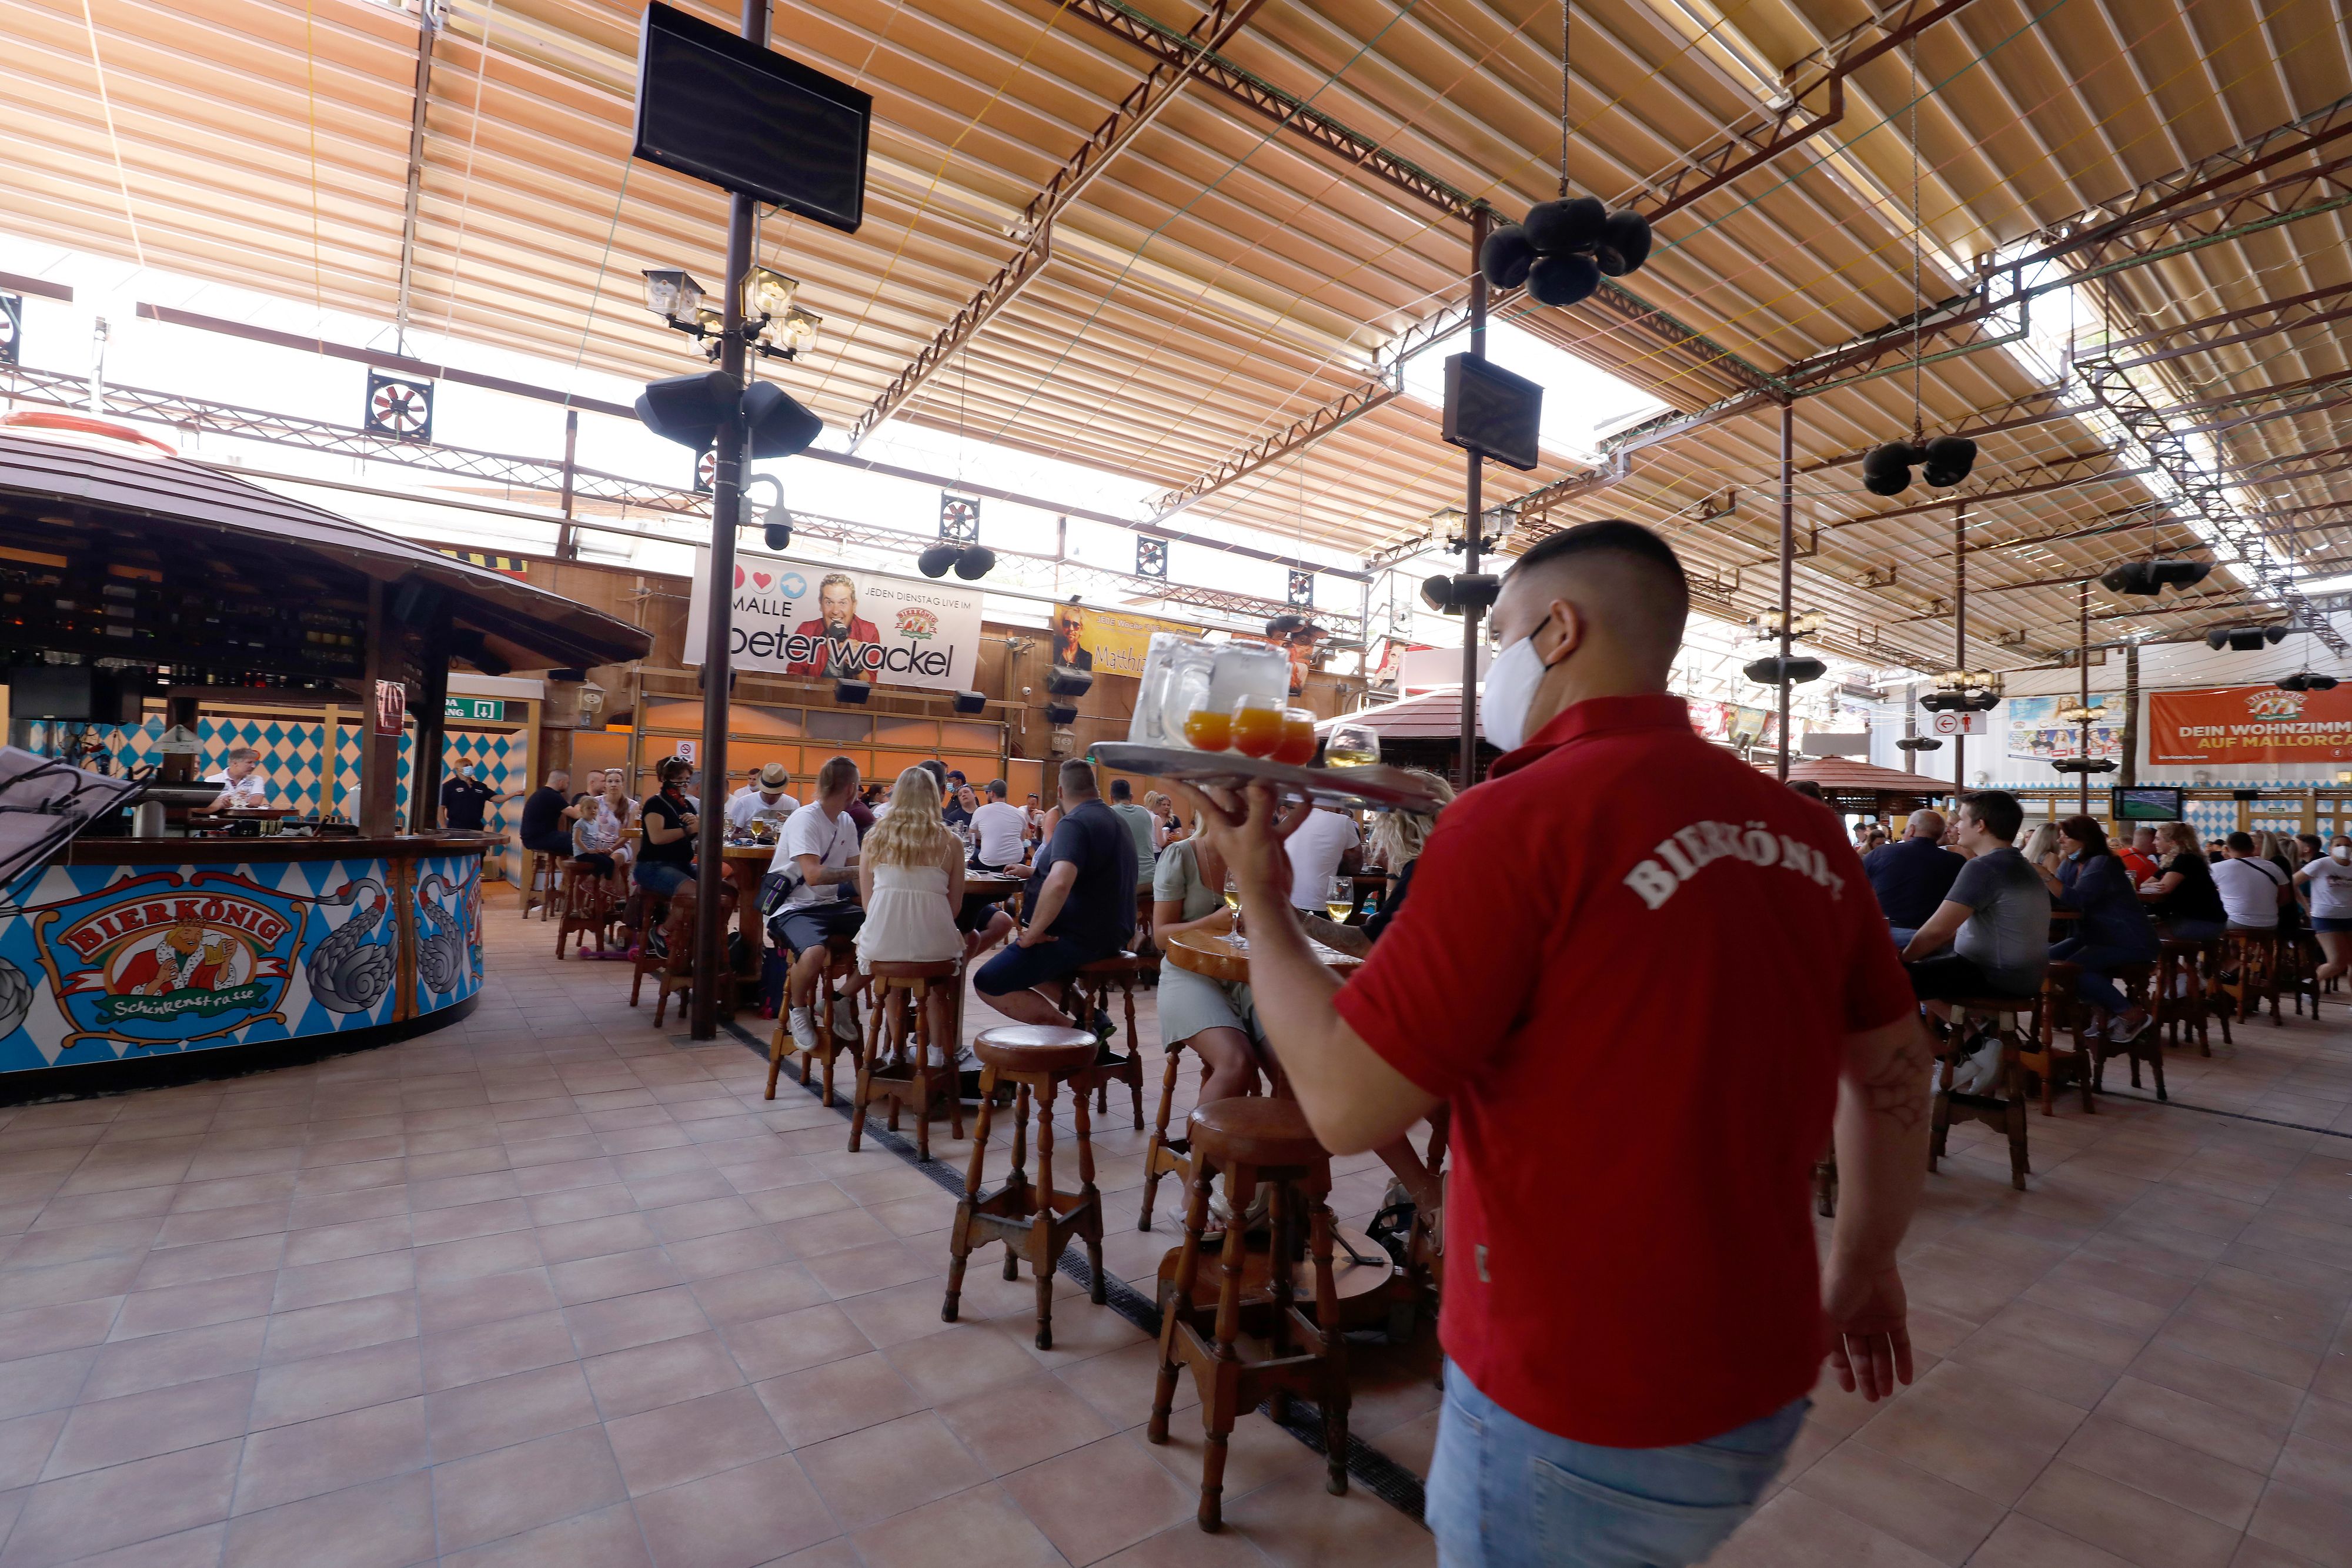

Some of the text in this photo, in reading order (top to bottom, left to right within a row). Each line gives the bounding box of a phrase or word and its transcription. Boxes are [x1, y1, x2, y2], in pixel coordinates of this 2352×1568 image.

[733, 596, 792, 617] MALLE
[865, 587, 894, 598] JEDEN
[897, 592, 940, 605] DIENSTAG
[943, 599, 959, 608] LIVE
[897, 609, 937, 623] BIERKÖNIG
[1096, 616, 1115, 626] JEDE
[1117, 619, 1142, 631] Woche
[830, 639, 953, 677] wackel
[2179, 726, 2225, 738] DEIN
[2197, 735, 2352, 749] AUF MALLORCA
[71, 898, 282, 952] BIERKÖNIG
[114, 989, 255, 1016] Schinkenstrasse
